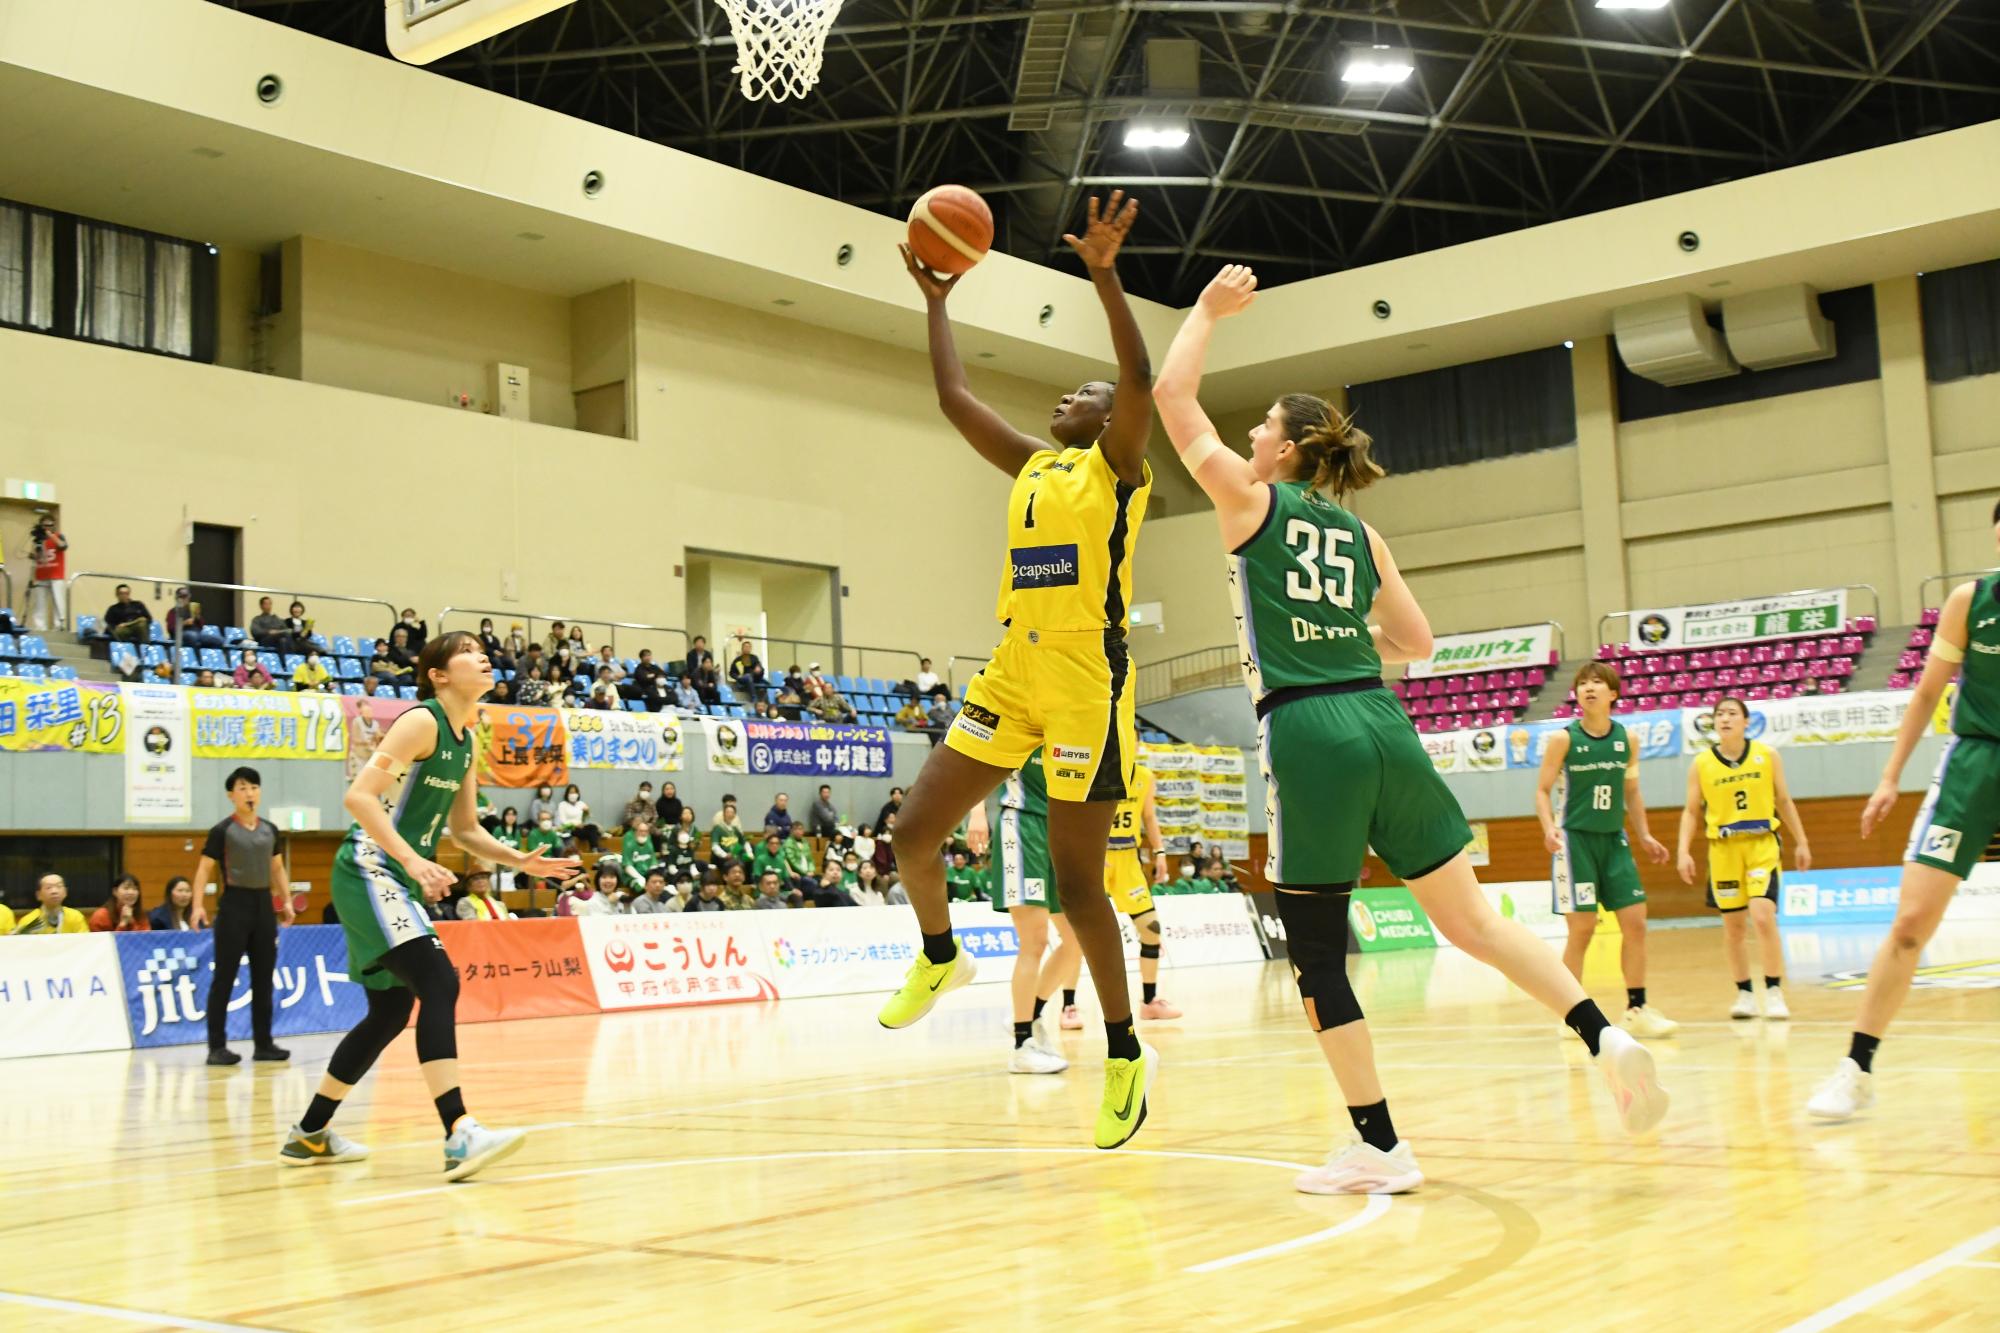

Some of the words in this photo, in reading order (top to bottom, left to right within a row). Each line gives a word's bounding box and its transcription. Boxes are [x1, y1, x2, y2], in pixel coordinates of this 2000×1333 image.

[1024, 491, 1036, 529] 1
[1286, 518, 1355, 609] 35
[299, 697, 343, 752] 72
[508, 712, 557, 751] 37
[815, 744, 887, 773] 中村建設
[1592, 784, 1612, 811] 18
[1734, 790, 1747, 811] 2
[1112, 811, 1132, 829] 45
[643, 936, 748, 971] こうしん
[137, 970, 206, 1037] jit
[617, 974, 743, 998] 甲府信用金庫
